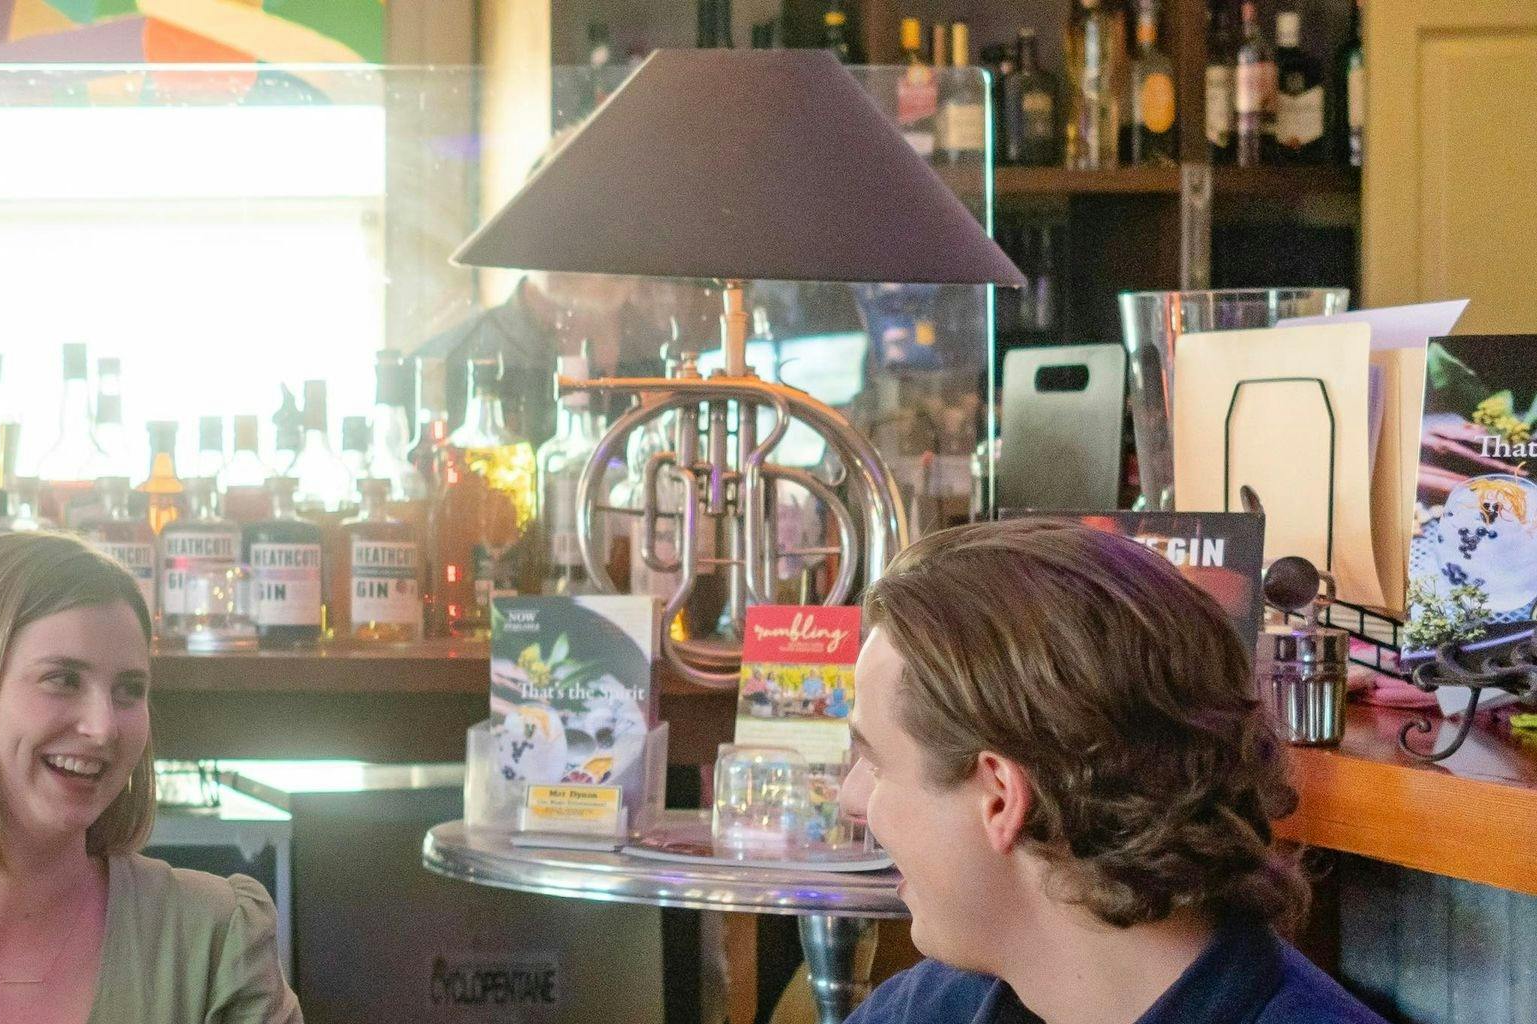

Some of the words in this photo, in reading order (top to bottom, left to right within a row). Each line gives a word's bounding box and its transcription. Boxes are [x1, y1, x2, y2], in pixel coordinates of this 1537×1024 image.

[254, 550, 319, 567] HEATHCOTE
[1167, 537, 1225, 567] GIN
[357, 581, 389, 598] GIN
[508, 611, 537, 622] NOW
[520, 682, 565, 699] That's
[568, 682, 594, 699] the
